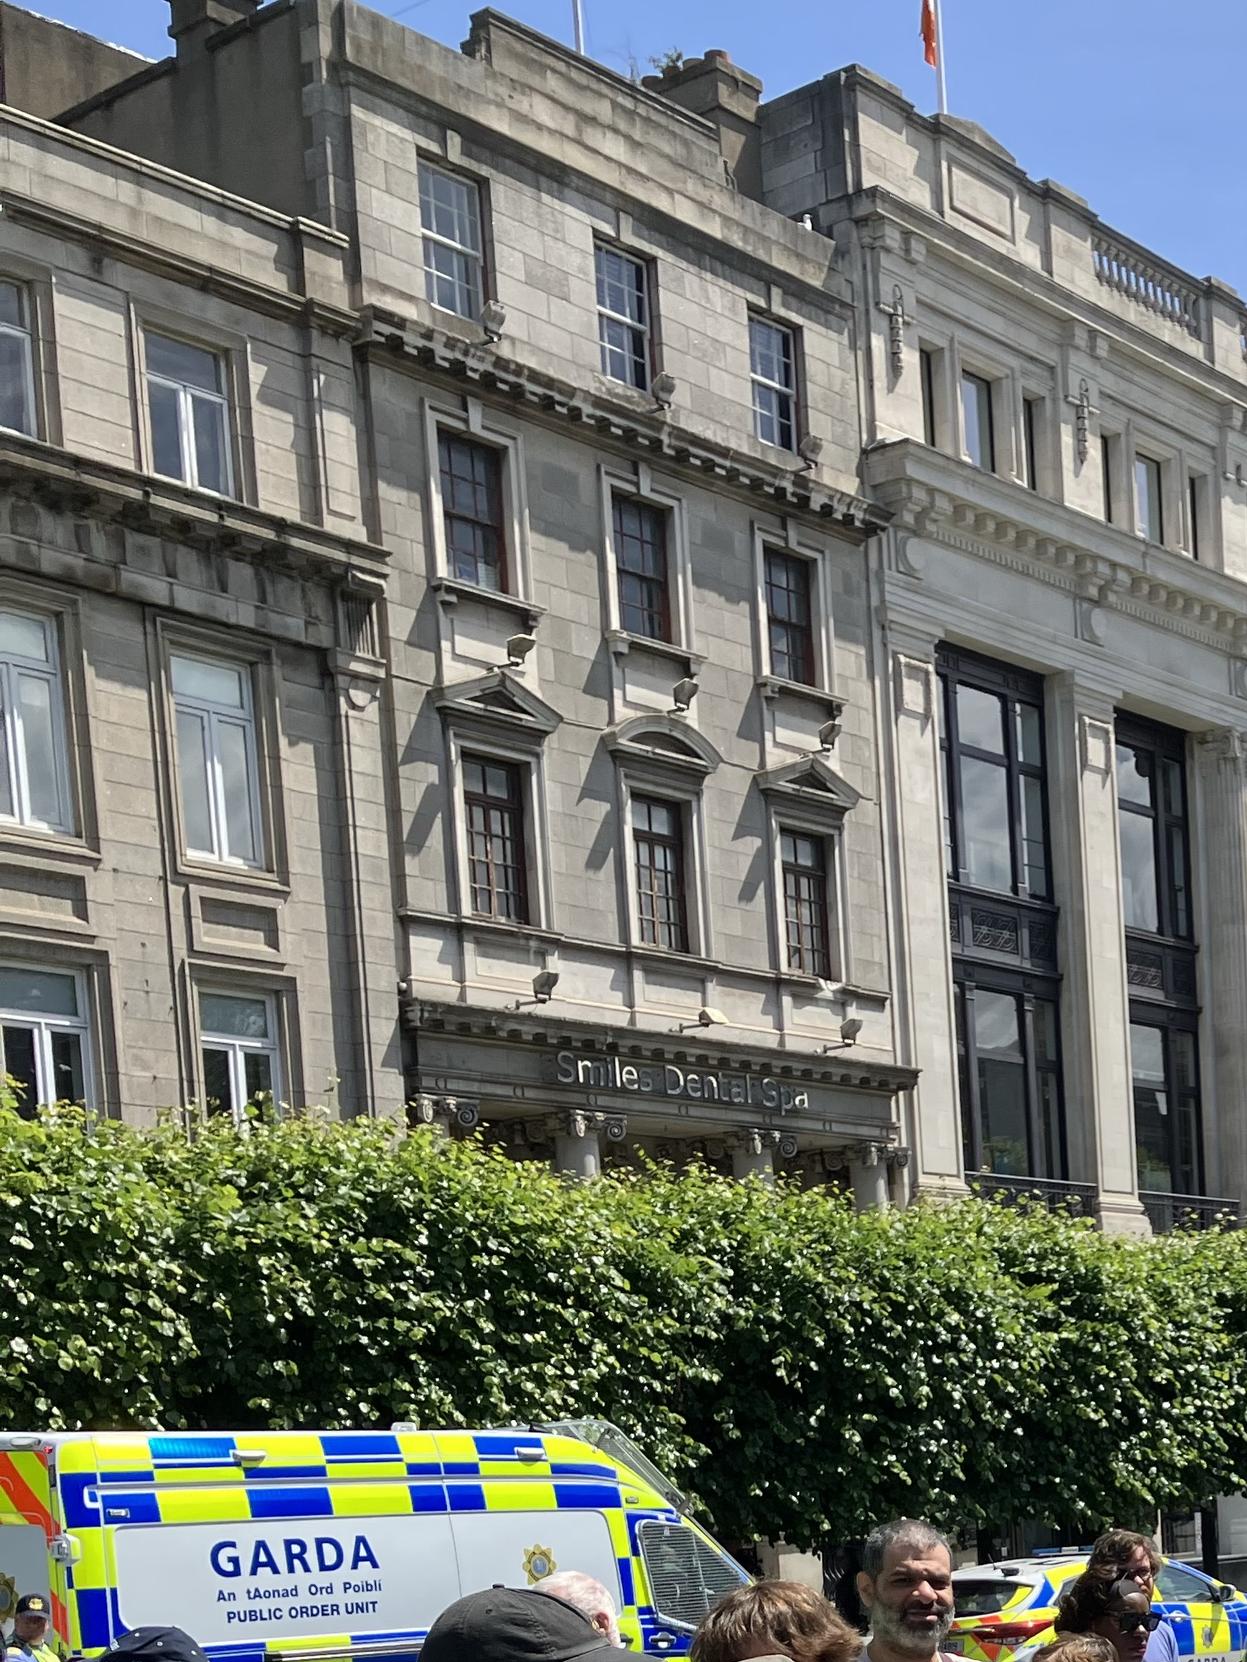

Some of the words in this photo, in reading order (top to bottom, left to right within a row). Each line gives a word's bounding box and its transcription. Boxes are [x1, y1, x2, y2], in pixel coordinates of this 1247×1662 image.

[557, 1051, 653, 1092] Smiles
[664, 1065, 752, 1104] Dental
[761, 1078, 809, 1116] Spa
[210, 1535, 381, 1578] GARDA
[217, 1589, 237, 1602] An
[247, 1585, 299, 1600] tAonad
[308, 1582, 334, 1596] Ord
[343, 1579, 382, 1594] Poiblí
[227, 1607, 283, 1624] PUBLIC
[288, 1603, 340, 1619] ORDER
[345, 1601, 378, 1615] UNIT
